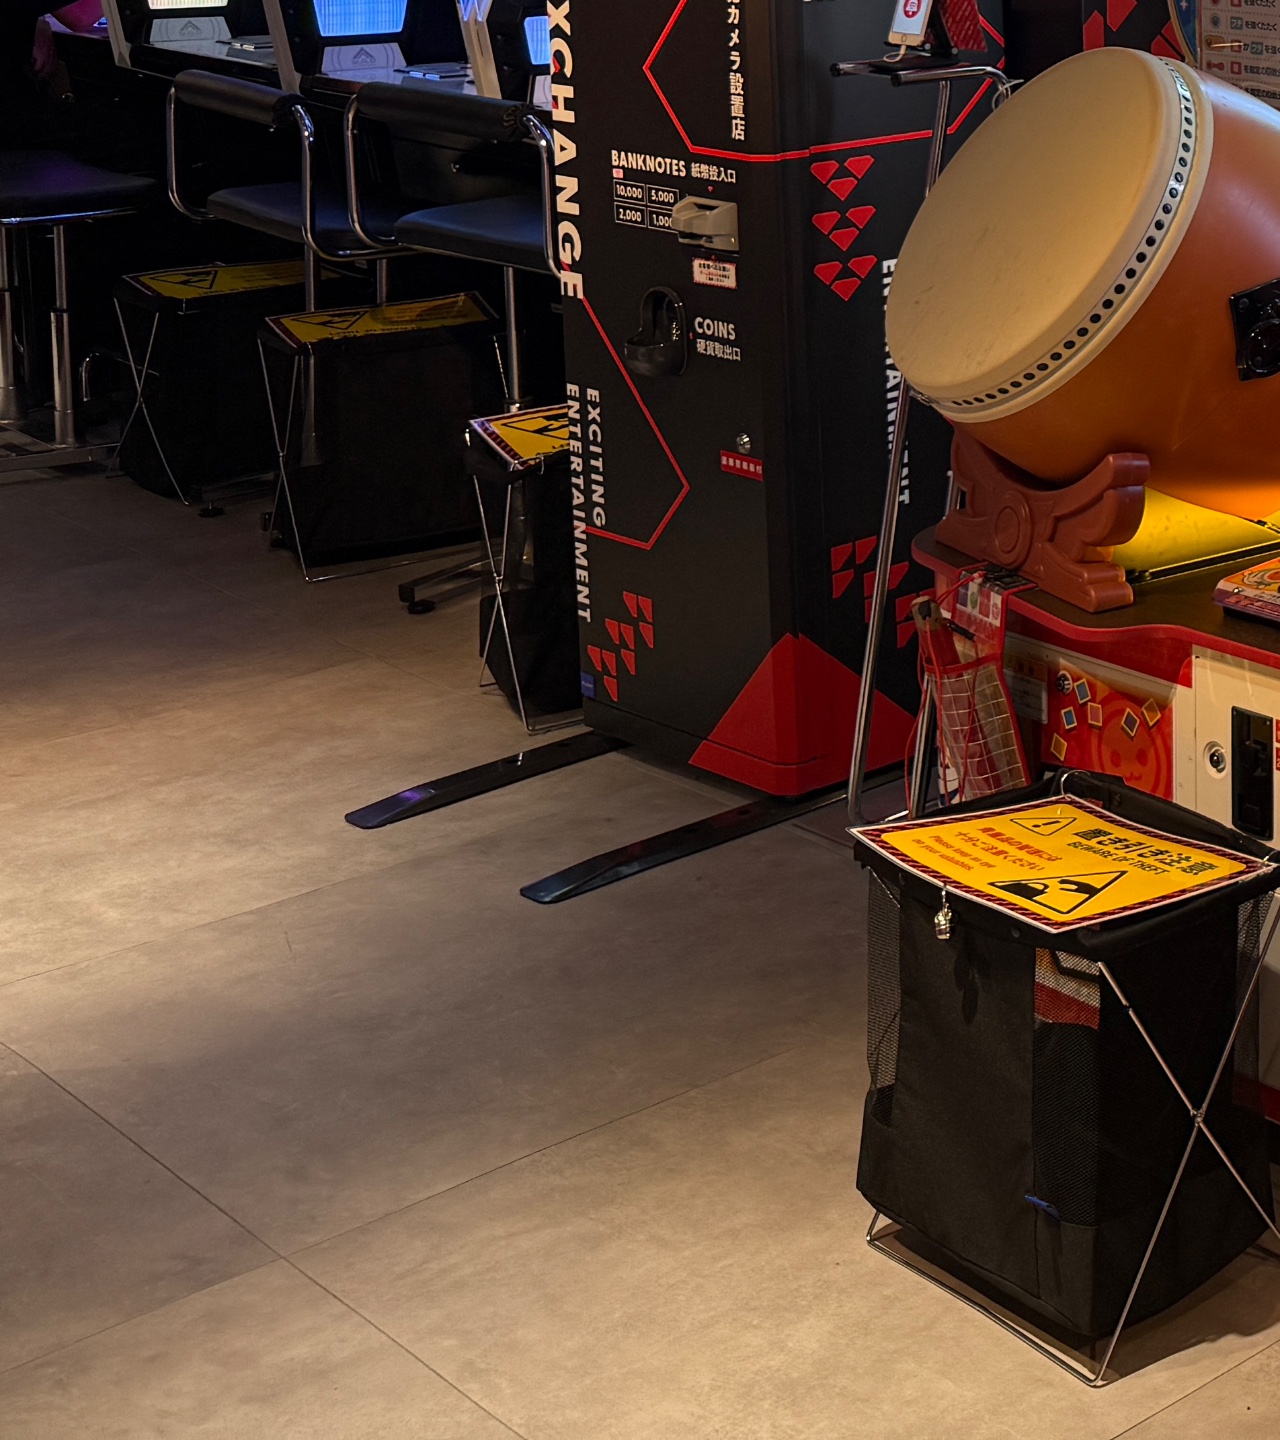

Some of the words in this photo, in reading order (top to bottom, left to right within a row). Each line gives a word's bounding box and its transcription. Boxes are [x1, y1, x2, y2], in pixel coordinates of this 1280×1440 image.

[611, 150, 687, 177] BANKNOTES
[691, 162, 736, 184] 紙幣投入口
[616, 185, 643, 199] 10,000
[651, 189, 674, 203] 5,000
[619, 208, 642, 222] 2,000
[694, 317, 736, 340] COINS
[696, 339, 741, 361] 硬貨取出口
[585, 388, 607, 527] EXCITING
[565, 383, 592, 623] ENTERTAINMENT
[928, 835, 953, 849] Please
[1072, 828, 1219, 876] 置き引き注意
[1067, 841, 1111, 862] BEWARE
[1130, 858, 1171, 875] THEFT
